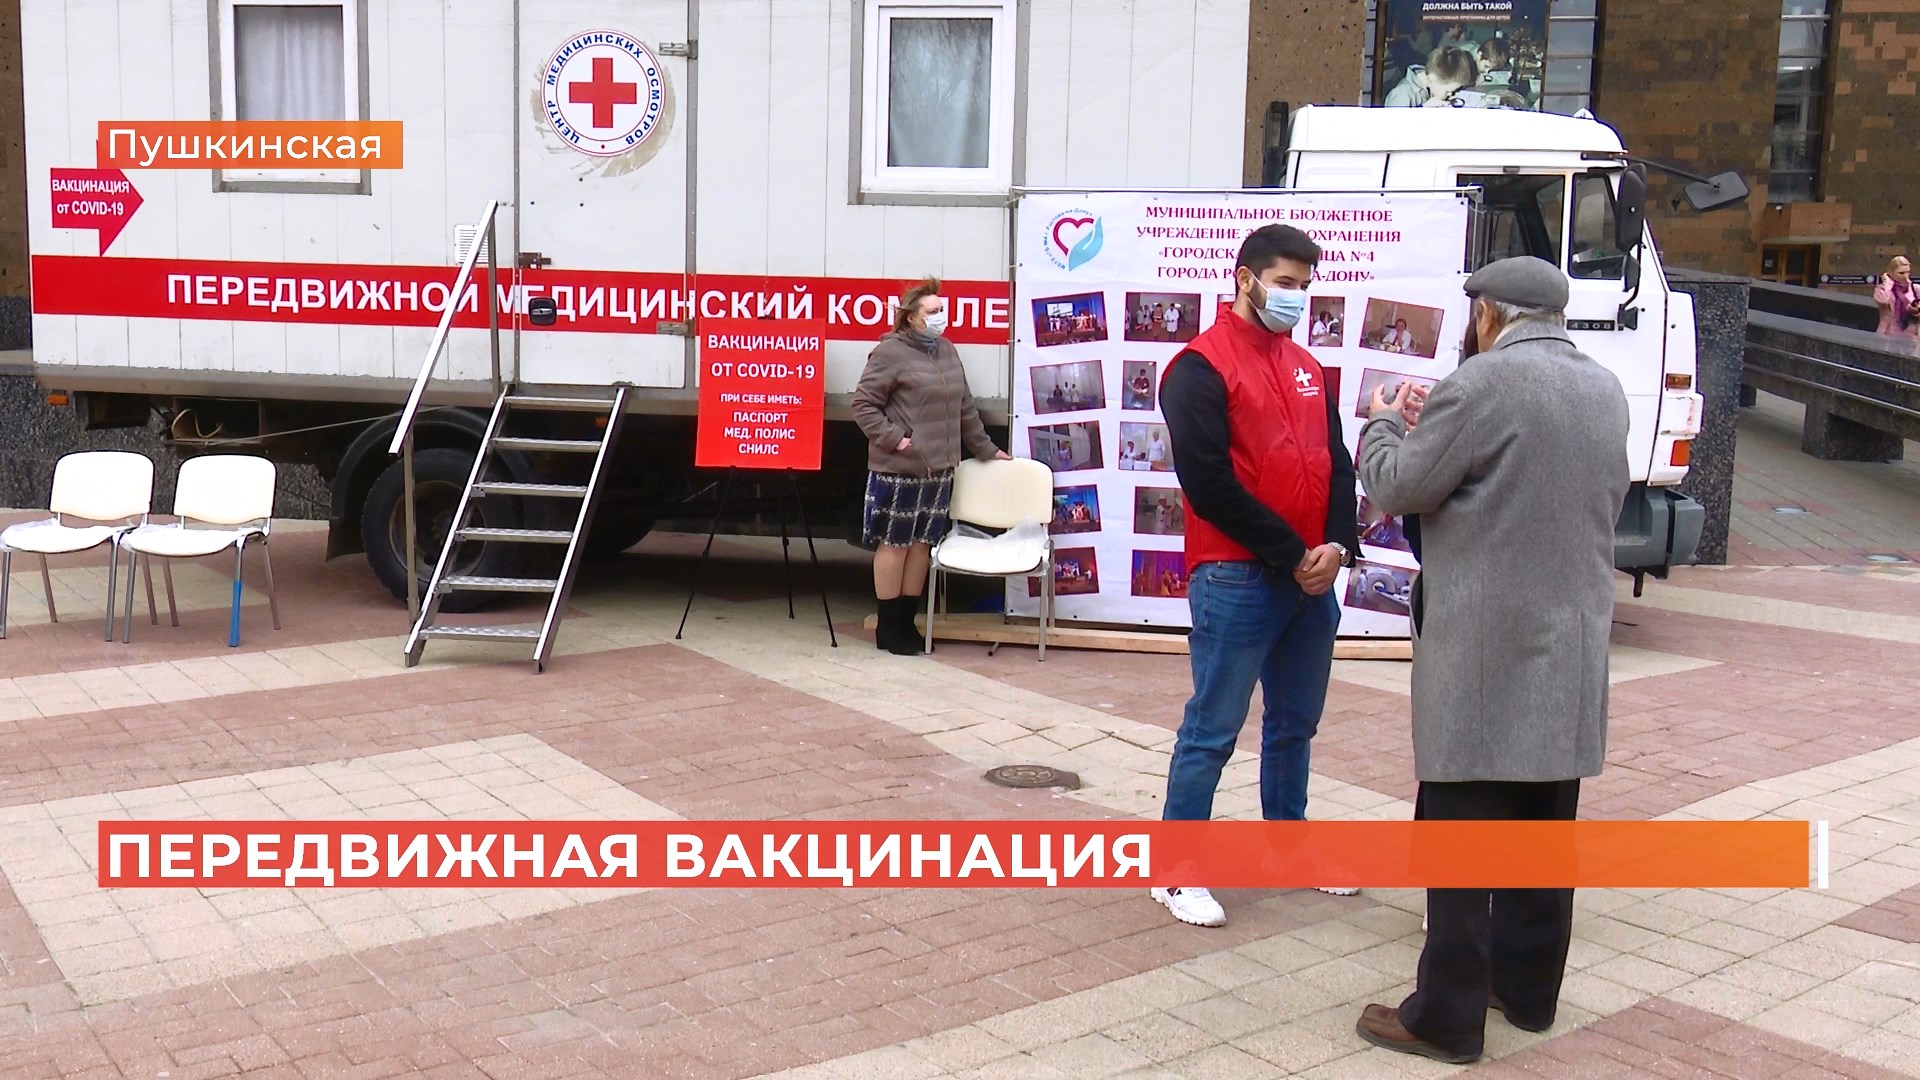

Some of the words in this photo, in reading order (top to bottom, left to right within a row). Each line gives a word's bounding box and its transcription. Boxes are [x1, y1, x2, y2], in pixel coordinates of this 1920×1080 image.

[1422, 2, 1459, 11] ДОЛЖНА
[1460, 2, 1484, 11] БЫТЬ
[1485, 1, 1513, 11] ТАКОЙ
[546, 34, 644, 85] МЕДИЦИНСКИХ
[625, 67, 660, 145] ОСМОТРОВ
[547, 100, 580, 143] ЦЕНТР
[52, 179, 130, 195] ВАКЦИНАЦИЯ
[57, 203, 70, 214] от
[71, 200, 124, 216] COVID-19
[1145, 206, 1285, 221] МУНИЦИПАЛЬНОЕ
[1290, 209, 1393, 223] БЮДЖЕТНОЕ
[1136, 226, 1241, 241] УЧРЕЖДЕНИЕ
[1158, 246, 1239, 261] «ГОРОДСК
[1350, 250, 1375, 263] №4
[1157, 266, 1218, 281] ГОРОДА
[168, 273, 479, 313] ПЕРЕДВИЖНОЙ
[708, 335, 819, 352] ВАКЦИНАЦИЯ
[711, 363, 733, 376] ОТ
[737, 363, 815, 379] COVID-19
[721, 393, 740, 403] ПРИ
[742, 394, 766, 403] СЕБЕ
[767, 395, 802, 405] ИМЕТЬ:
[733, 412, 788, 423] ПАСПОРТ
[724, 427, 751, 440] МЕД.
[755, 428, 796, 440] ПОЛИС
[738, 443, 779, 455] СНИЛС
